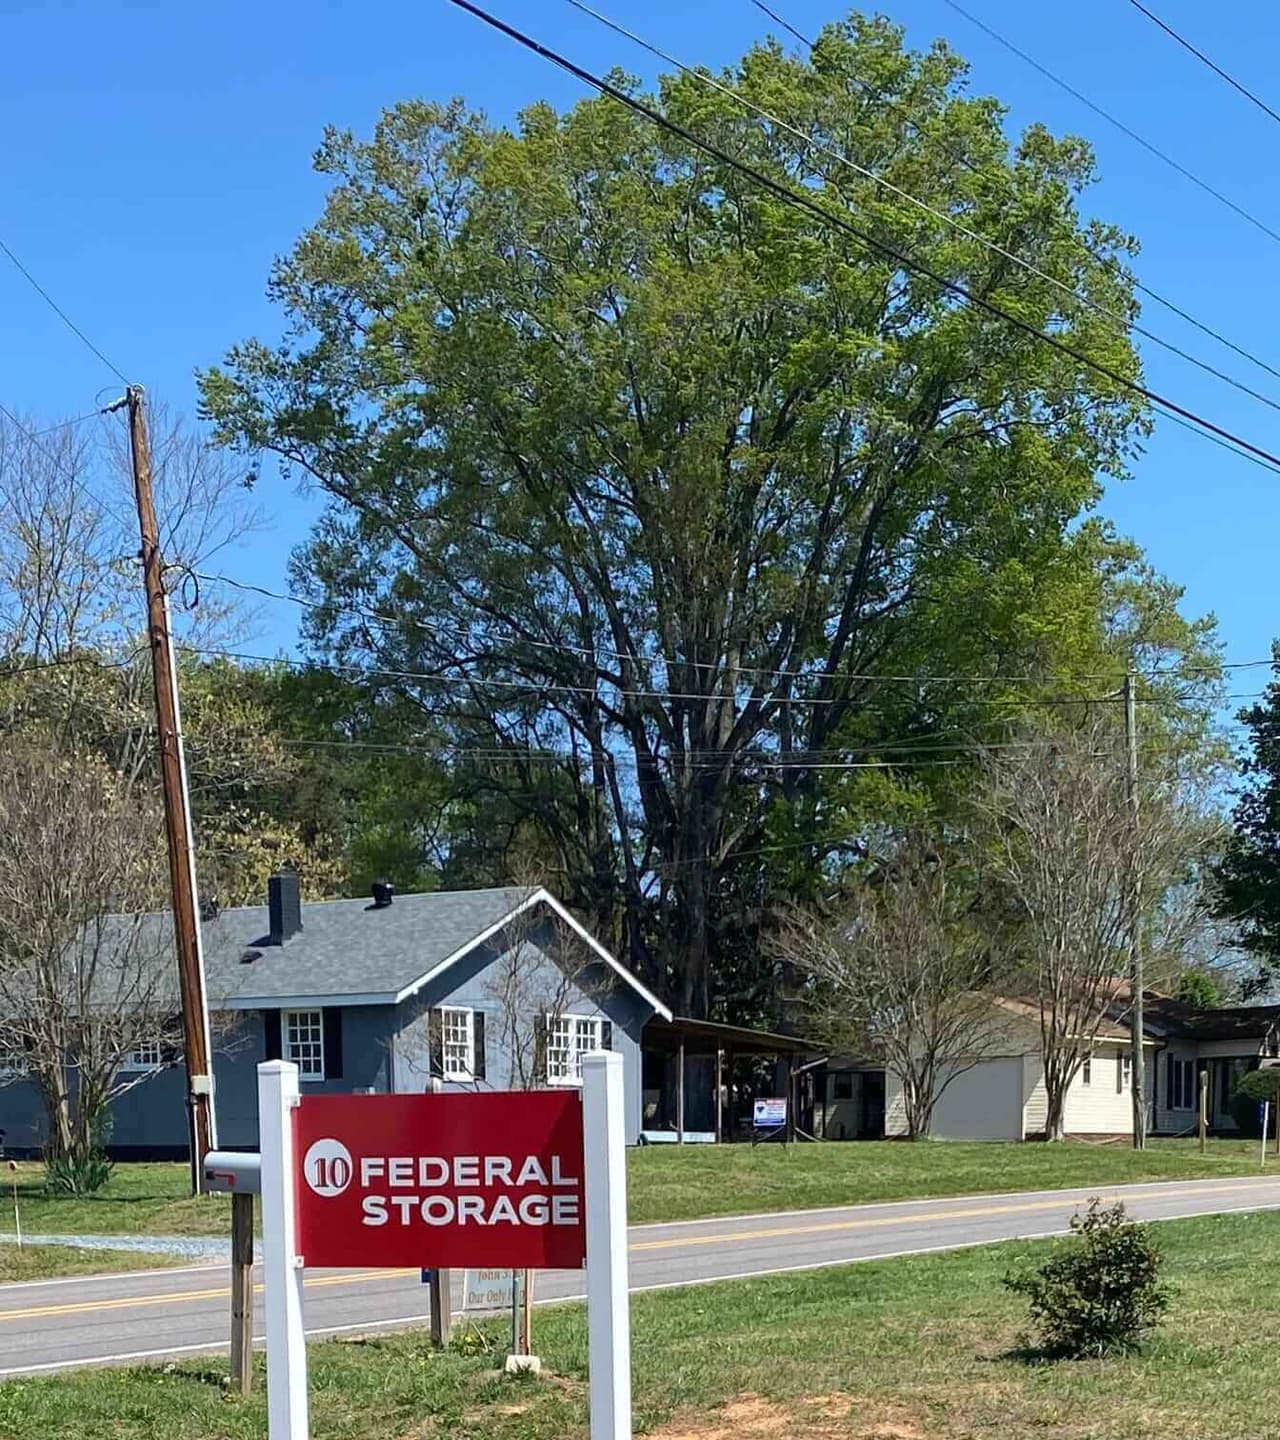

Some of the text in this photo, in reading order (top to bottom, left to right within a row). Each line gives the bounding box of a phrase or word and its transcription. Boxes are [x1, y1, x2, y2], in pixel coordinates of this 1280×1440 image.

[313, 1156, 579, 1188] 10 FEDERAL
[362, 1195, 579, 1226] STORAGE
